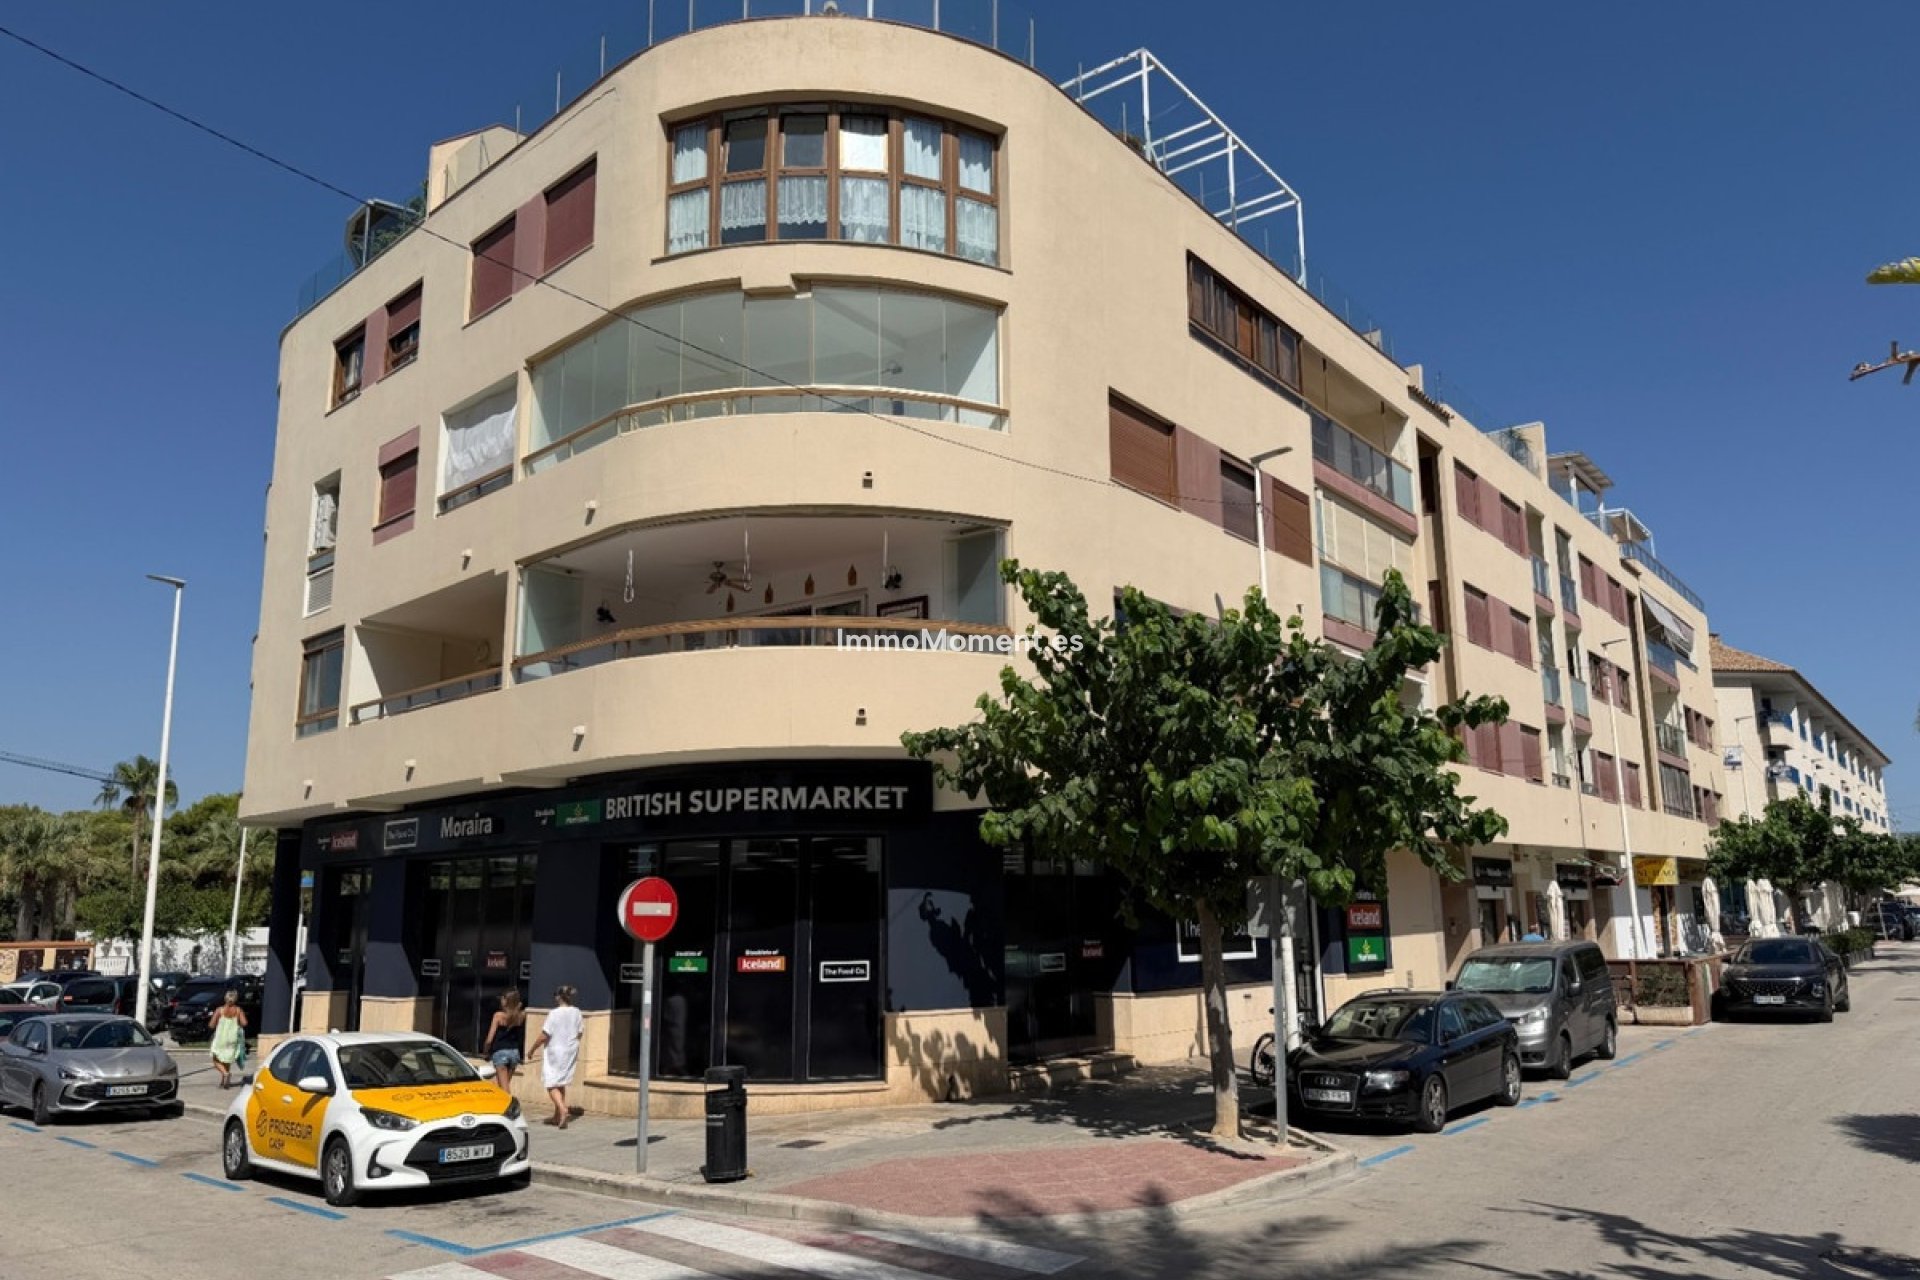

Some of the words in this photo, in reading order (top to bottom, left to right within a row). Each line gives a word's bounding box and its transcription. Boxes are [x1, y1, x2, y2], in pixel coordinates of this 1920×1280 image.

[605, 791, 681, 820] BRITISH
[688, 786, 908, 813] SUPERMARKET
[440, 811, 492, 838] Moraira
[742, 959, 781, 970] Iceland
[269, 1118, 313, 1140] PROSEGUR
